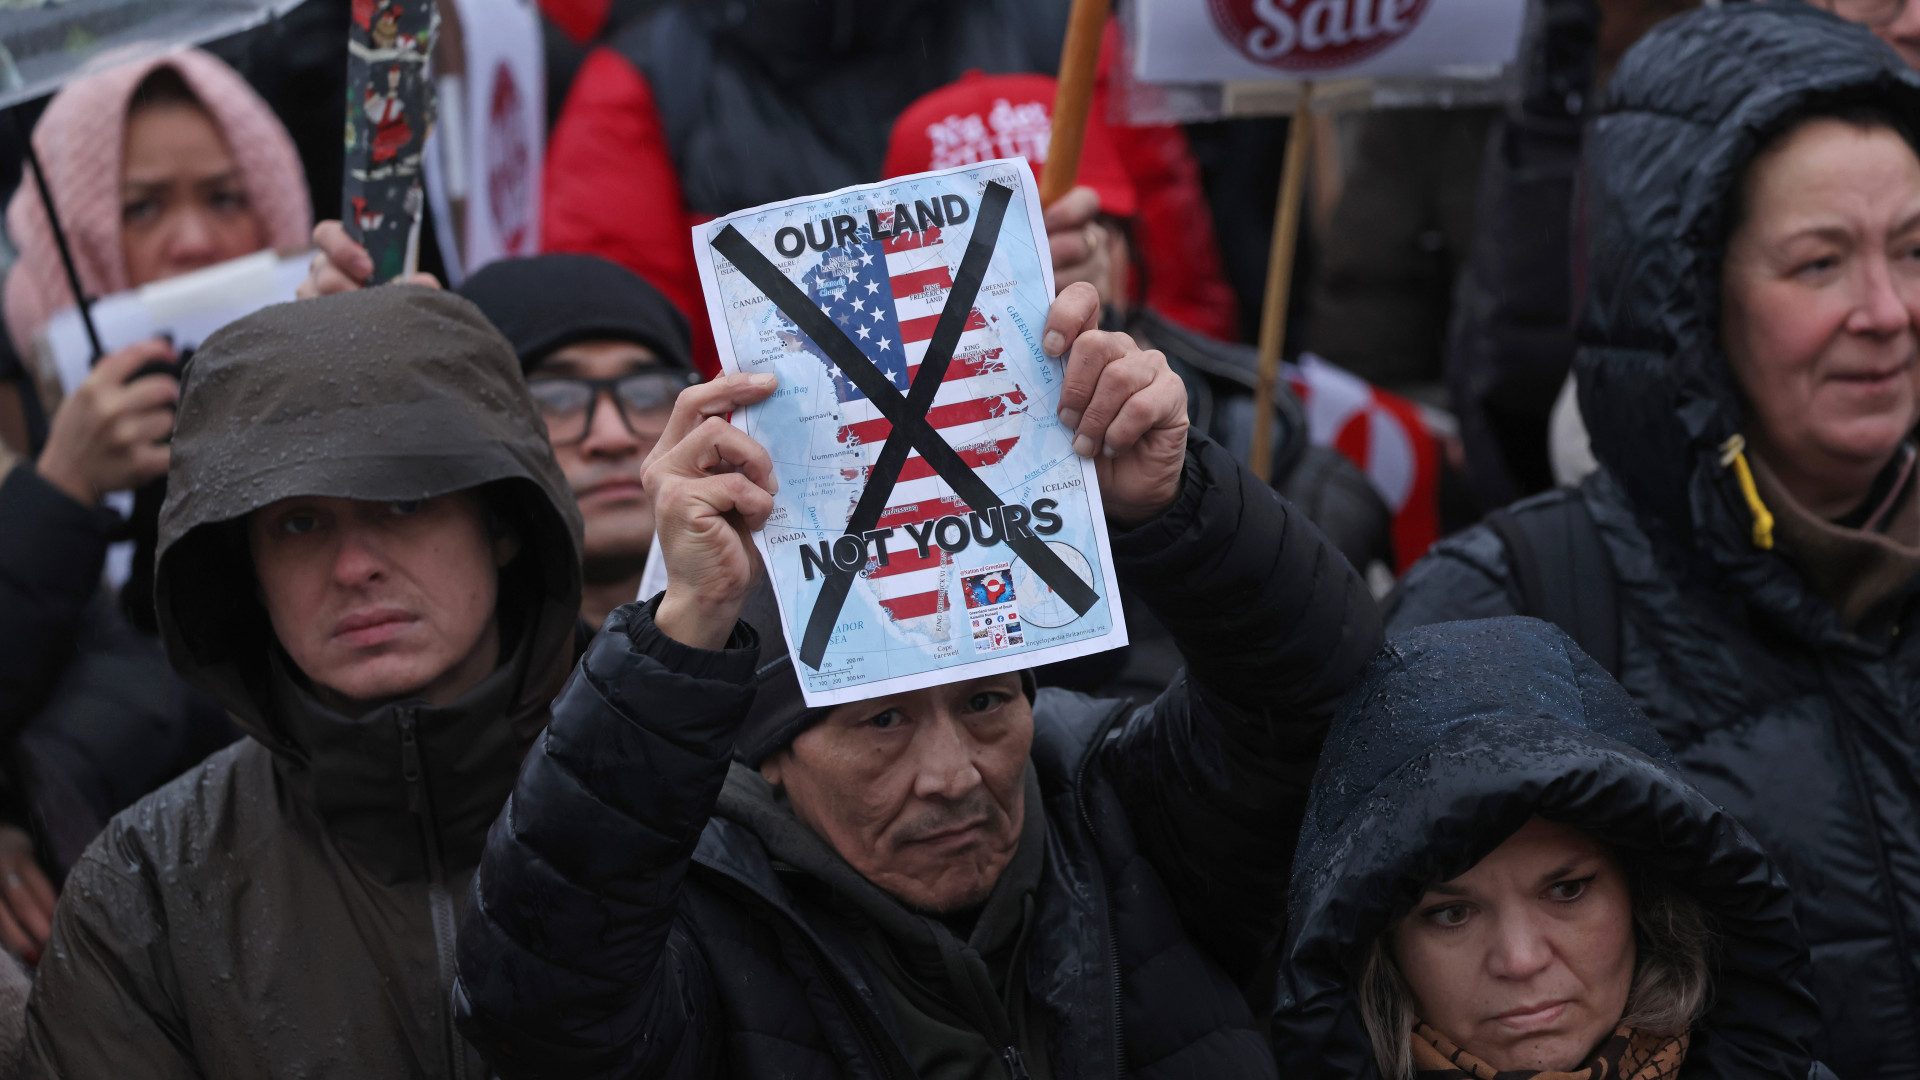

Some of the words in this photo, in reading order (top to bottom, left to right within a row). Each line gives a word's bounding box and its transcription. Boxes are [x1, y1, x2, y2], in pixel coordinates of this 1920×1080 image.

[1247, 0, 1411, 60] Sale
[881, 199, 897, 208] Cape
[774, 214, 862, 260] OUR
[867, 193, 971, 241] LAND
[981, 280, 1018, 292] GREENLAND
[991, 288, 1010, 297] BASIN
[964, 343, 980, 351] KING
[1006, 305, 1045, 364] GREENLAND
[1039, 364, 1053, 385] SEA
[751, 357, 768, 366] Space
[770, 353, 784, 361] Base
[772, 388, 791, 399] affin
[794, 386, 809, 395] Bay
[799, 411, 833, 424] Upernavik
[1042, 479, 1082, 494] ICELAND
[770, 531, 808, 545] CANADA
[799, 527, 894, 581] NOT
[901, 498, 1063, 559] YOURS
[937, 645, 953, 653] Cape
[857, 673, 866, 681] km
